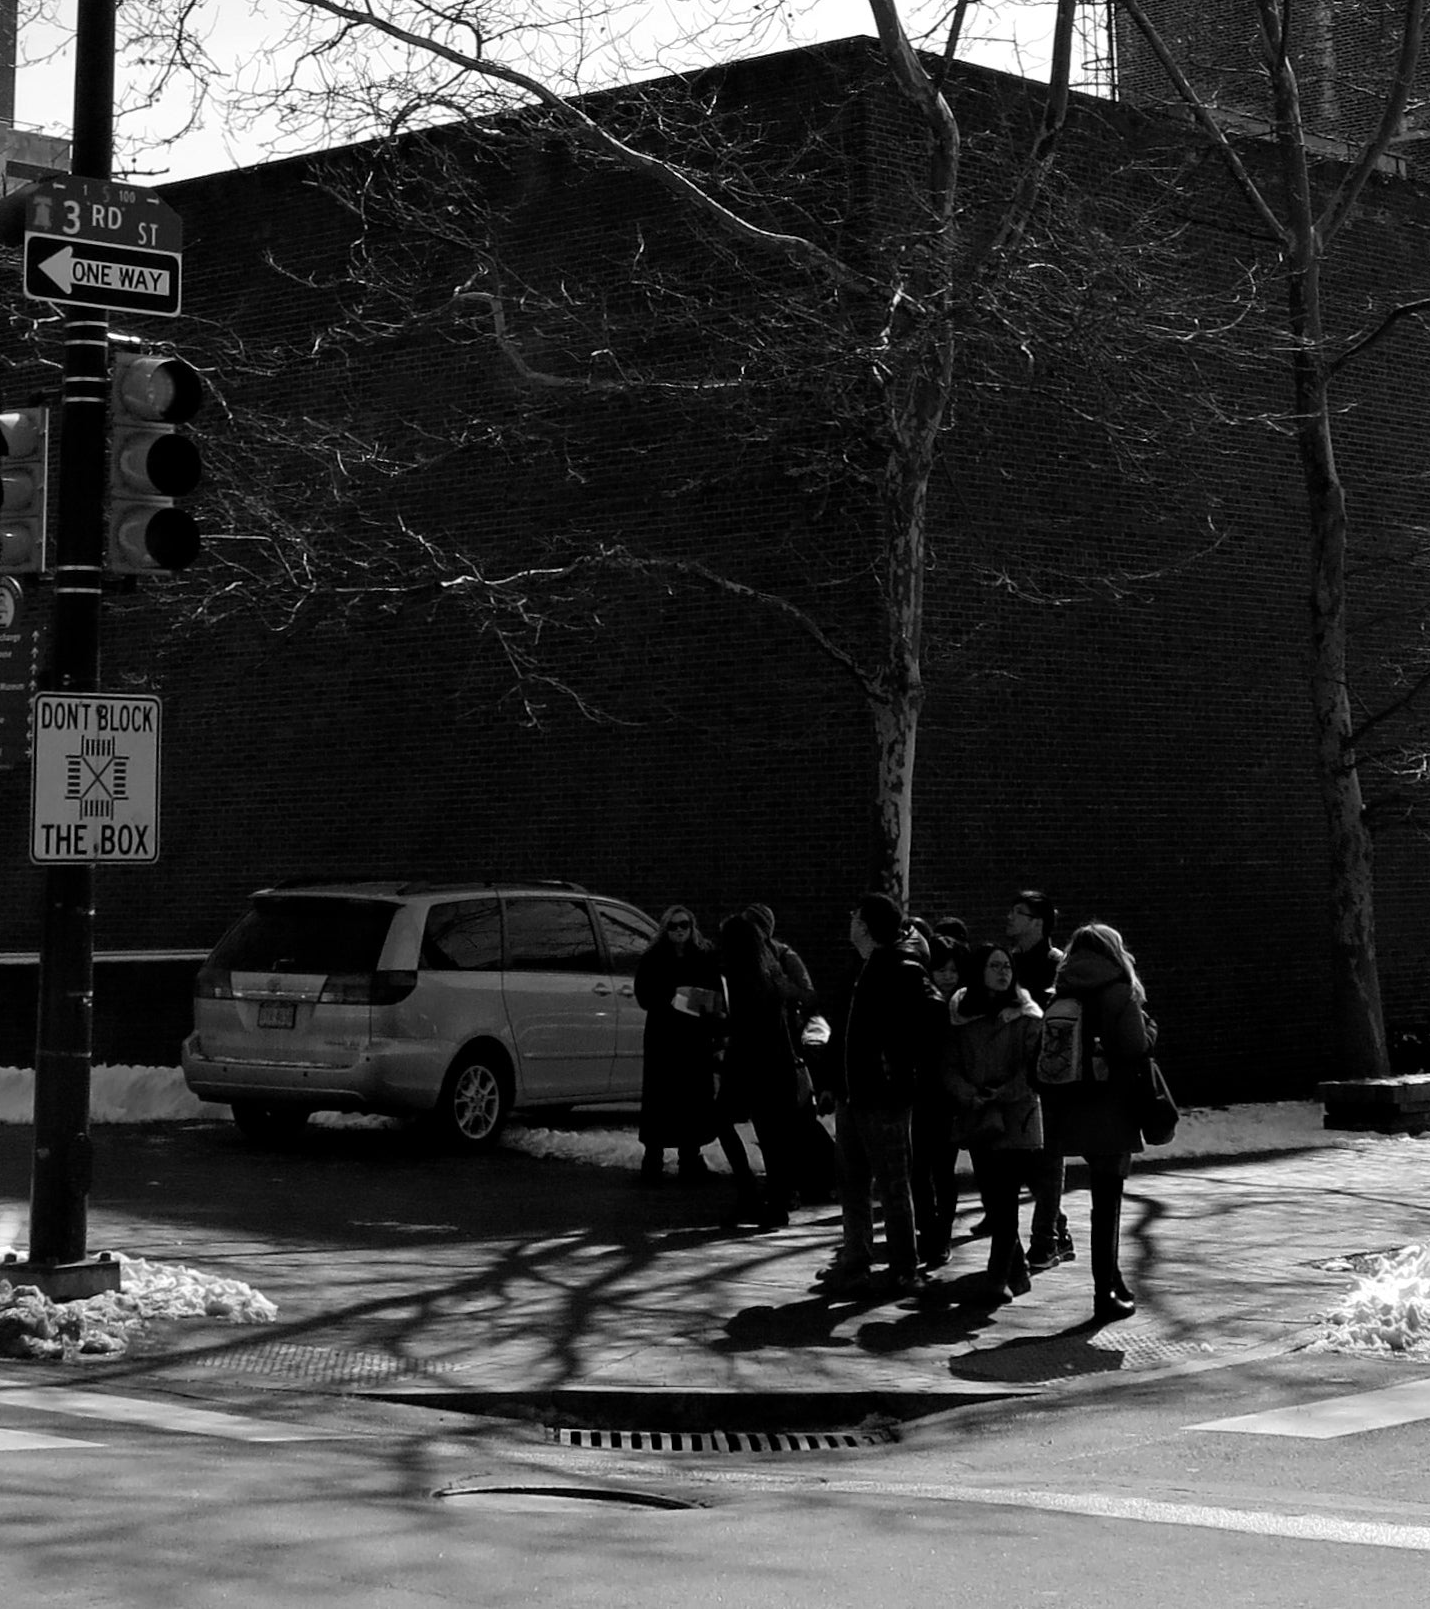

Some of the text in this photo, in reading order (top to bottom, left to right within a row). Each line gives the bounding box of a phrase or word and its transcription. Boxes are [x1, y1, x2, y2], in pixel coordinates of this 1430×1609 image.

[119, 190, 136, 204] 100
[137, 222, 159, 247] ST
[72, 261, 163, 293] ONE WAY
[96, 704, 153, 733] BLOCK
[41, 824, 149, 855] THE BOX
